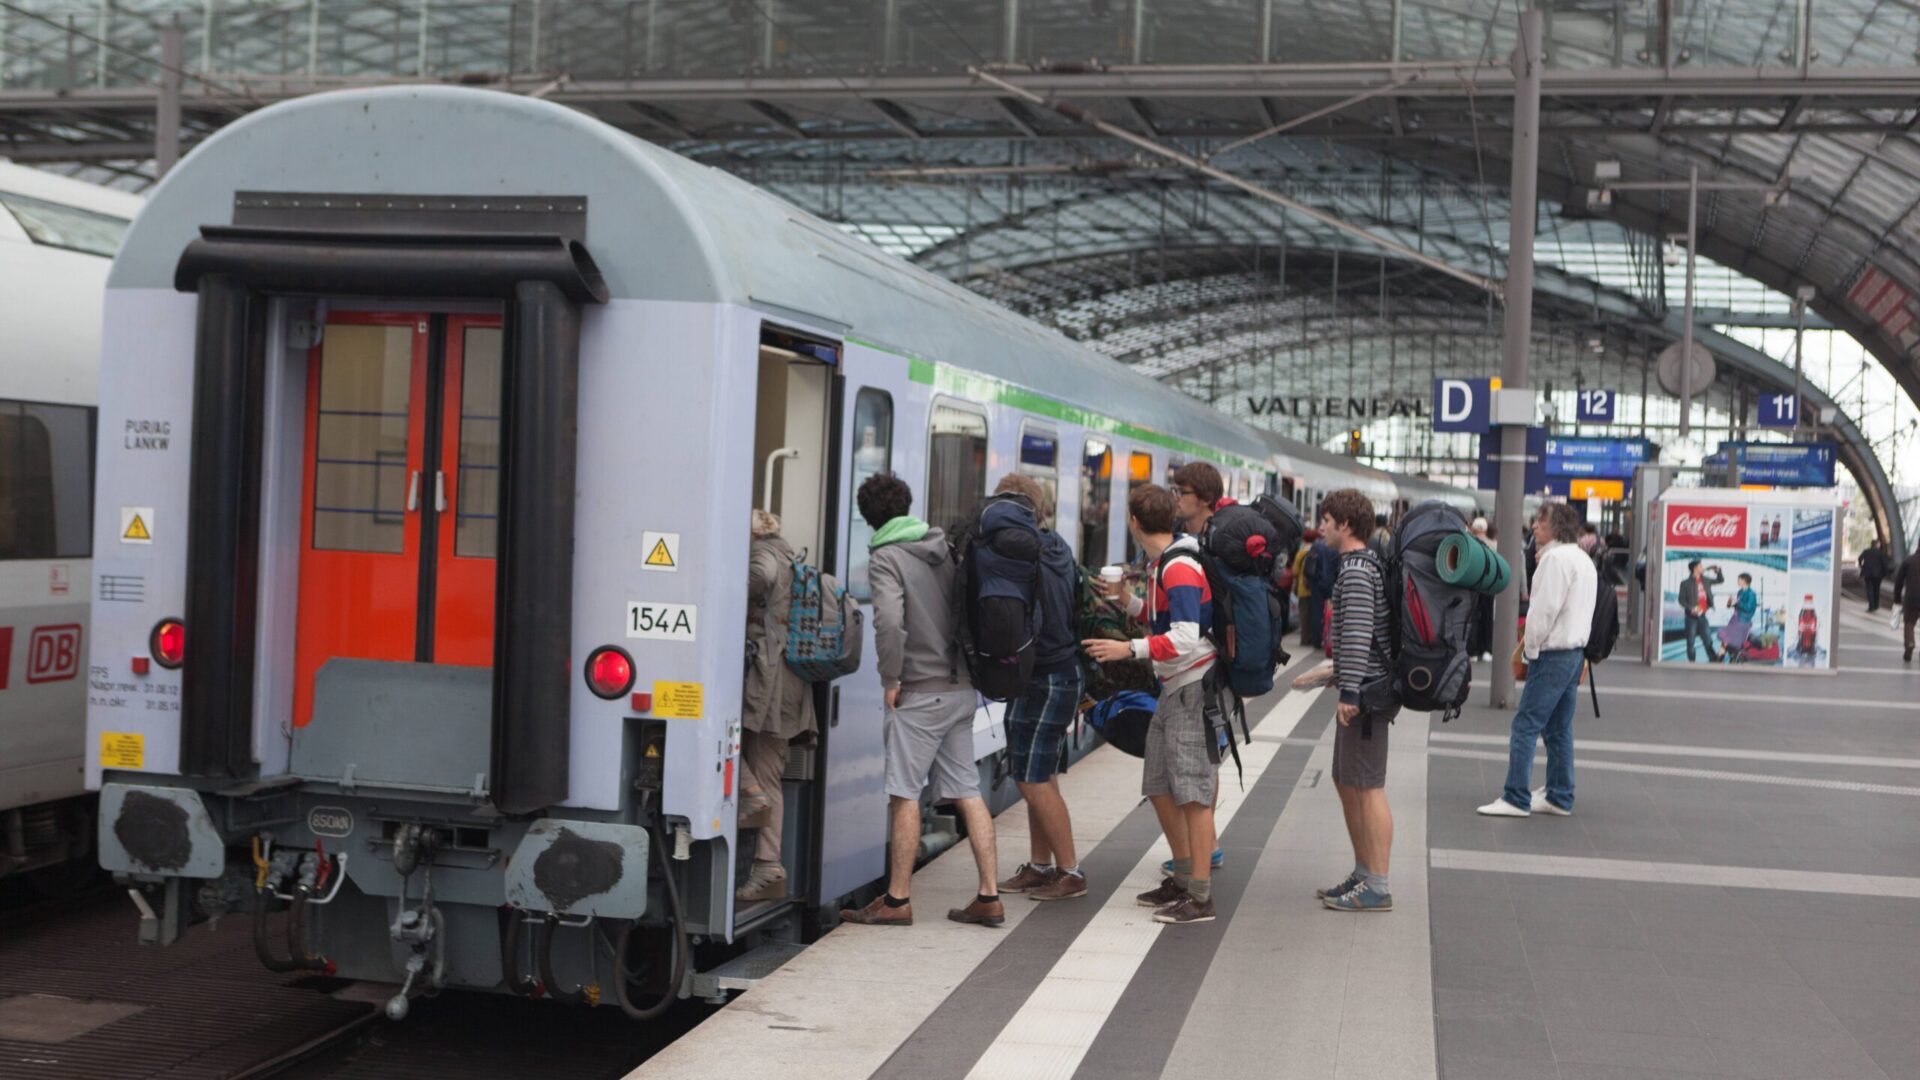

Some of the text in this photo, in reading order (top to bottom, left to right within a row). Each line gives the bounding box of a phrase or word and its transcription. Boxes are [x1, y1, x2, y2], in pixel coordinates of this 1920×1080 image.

[1247, 397, 1433, 418] VATTENFAL
[1441, 380, 1473, 423] D
[1581, 390, 1607, 415] 12
[1772, 394, 1794, 419] 11
[124, 436, 169, 450] LANKW
[1546, 440, 1557, 455] 12
[1817, 448, 1829, 462] 11
[1672, 512, 1741, 538] Coca-Cola
[34, 633, 74, 673] DB
